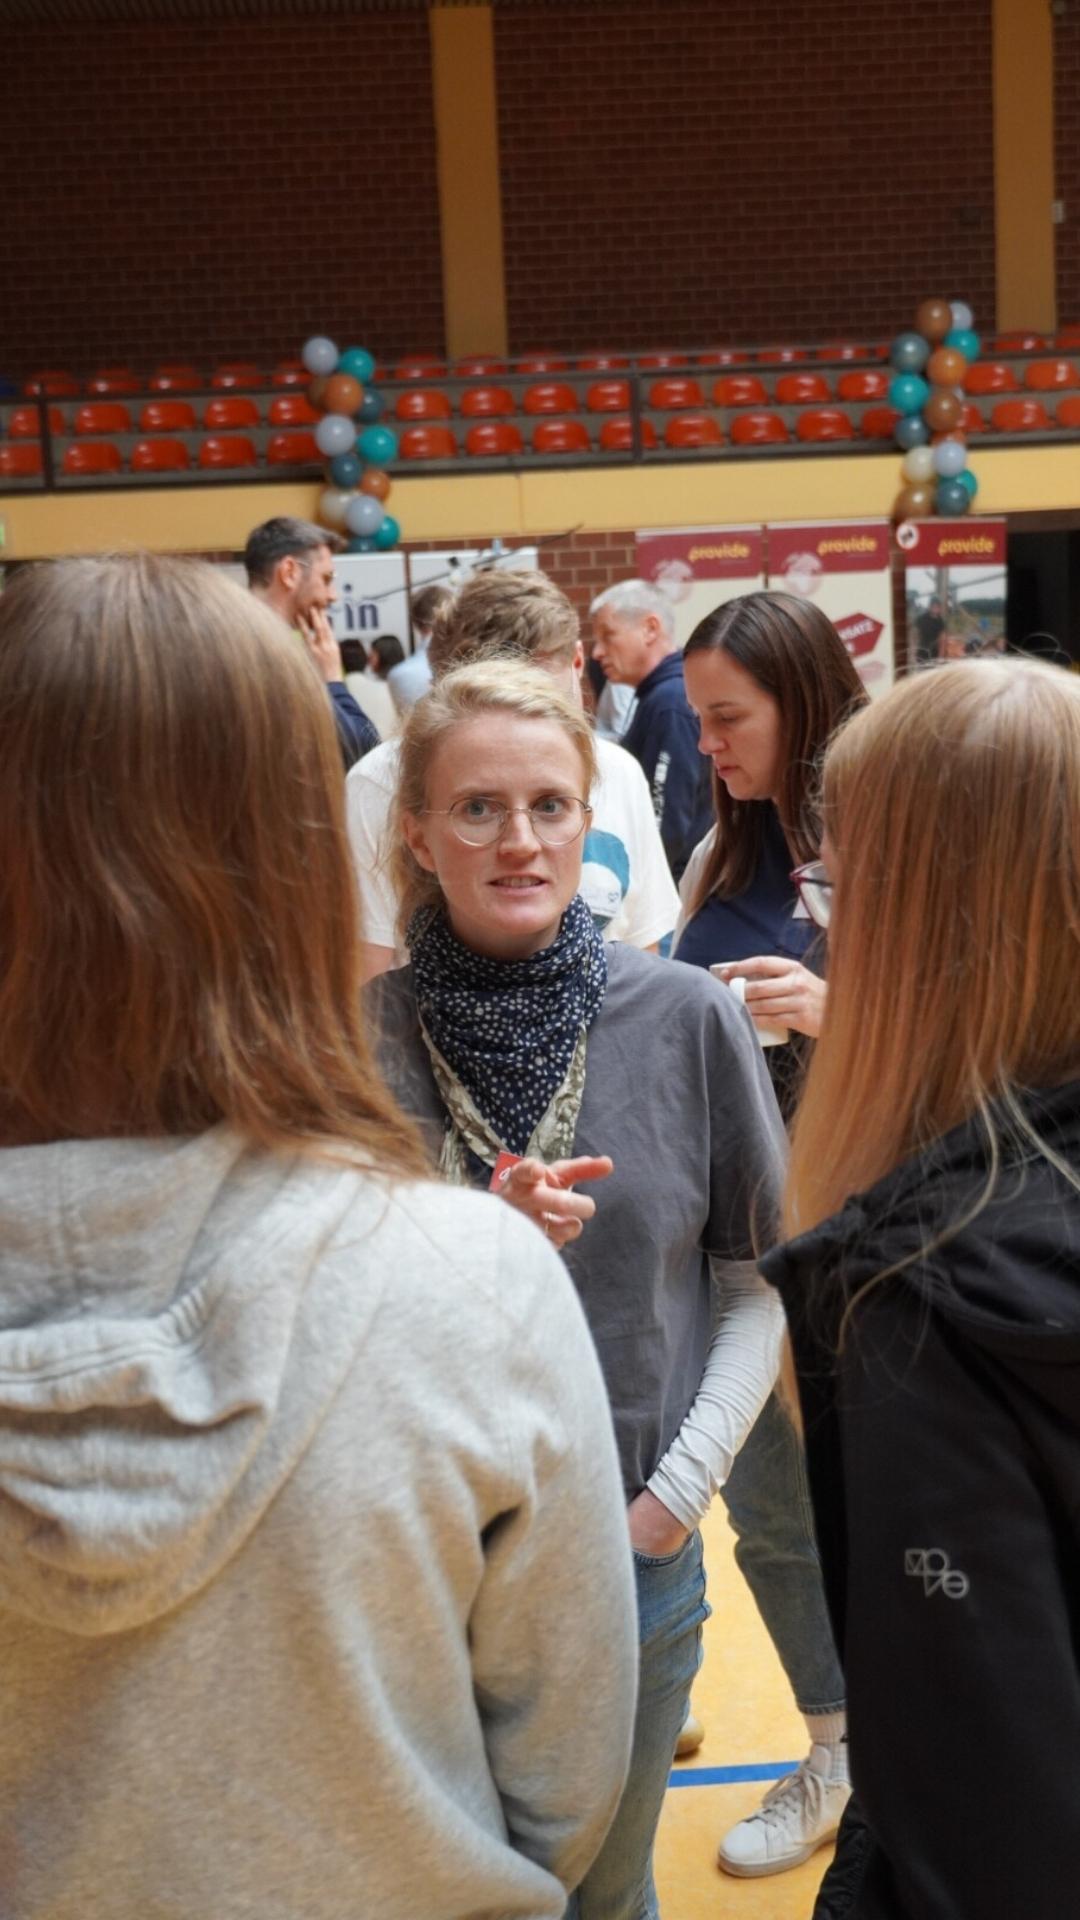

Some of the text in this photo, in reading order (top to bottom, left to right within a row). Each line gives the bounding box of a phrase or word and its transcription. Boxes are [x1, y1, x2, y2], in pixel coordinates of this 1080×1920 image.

[688, 541, 750, 563] provide
[817, 534, 877, 556] provide
[938, 535, 995, 556] provide
